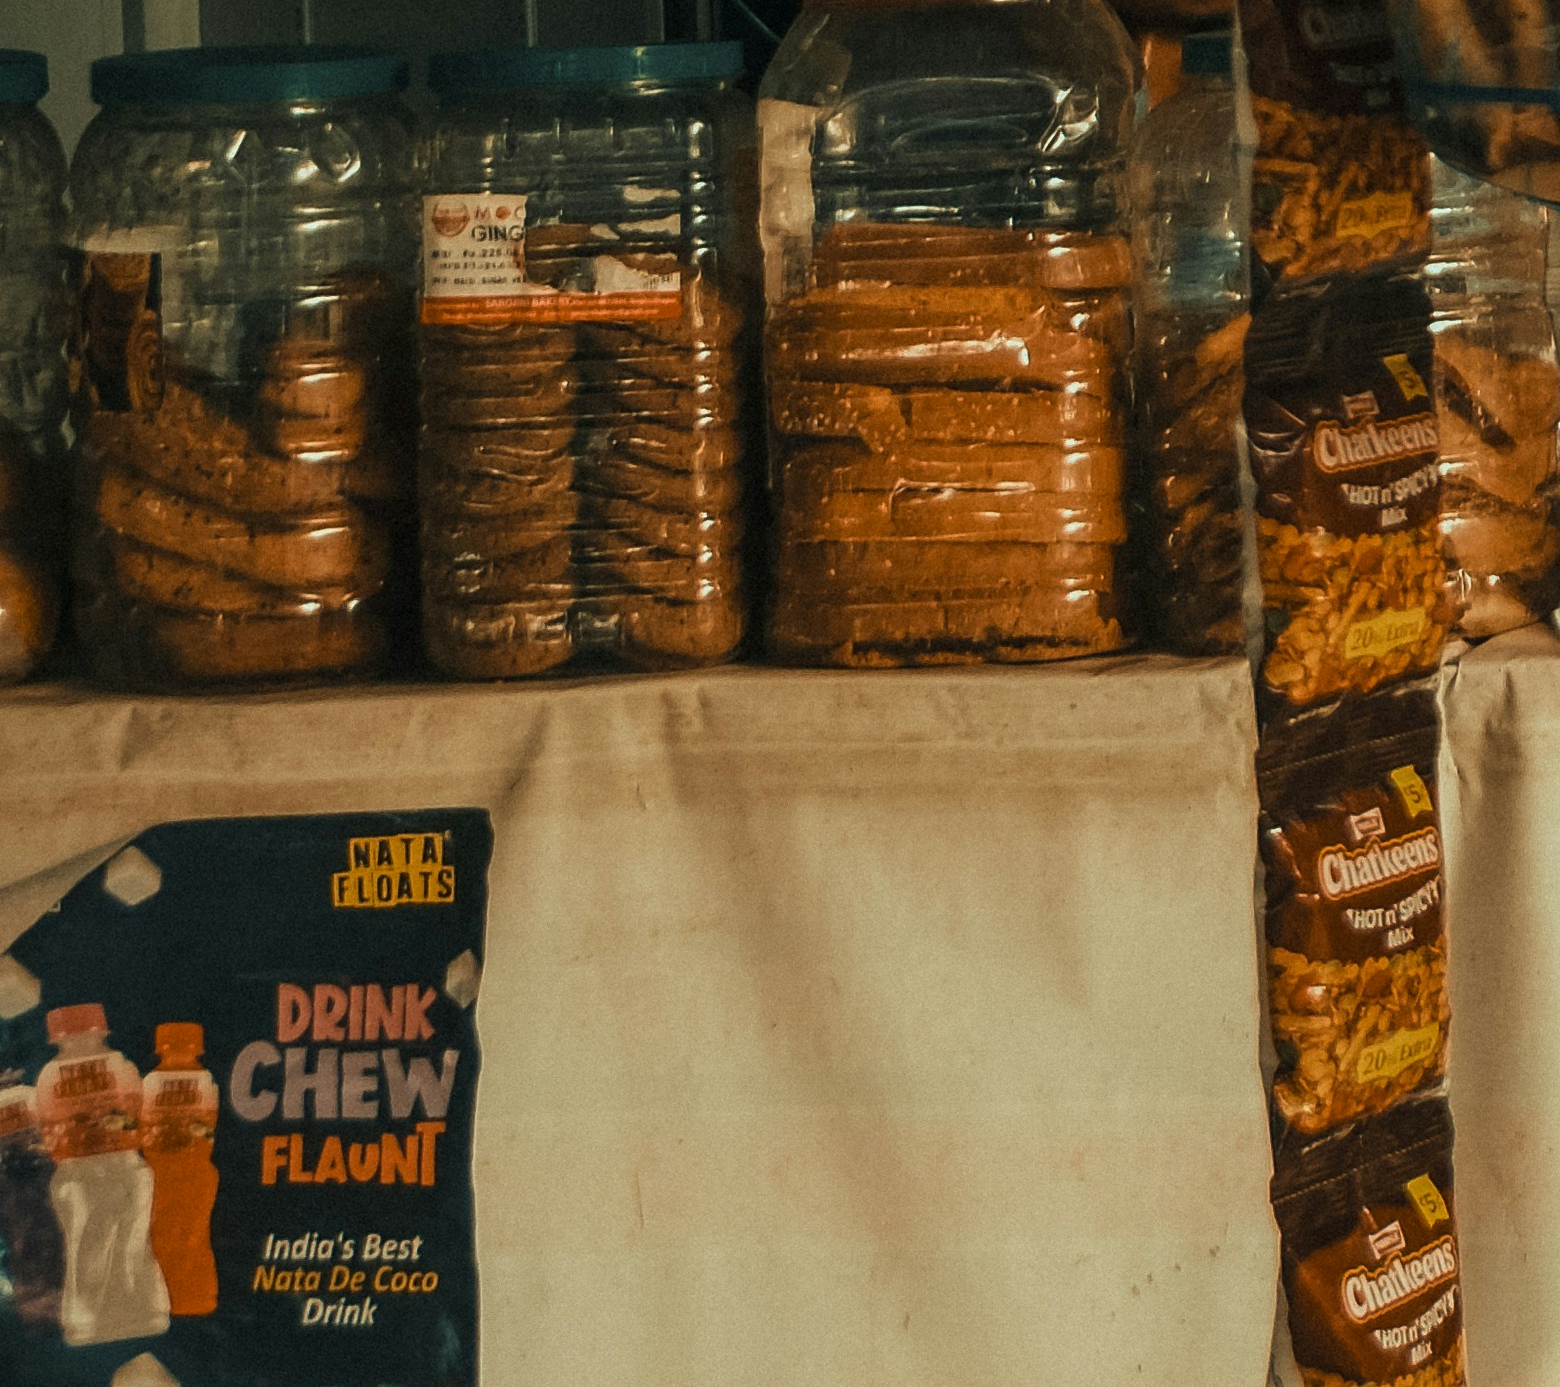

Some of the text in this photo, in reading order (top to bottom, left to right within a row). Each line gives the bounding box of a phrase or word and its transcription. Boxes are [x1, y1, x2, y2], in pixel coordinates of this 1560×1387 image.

[1318, 419, 1438, 468] Chatkeens
[351, 838, 442, 868] NATA
[1322, 832, 1440, 896] Chatkeens
[335, 868, 455, 905] FLOATS
[277, 983, 437, 1042] DRINK
[230, 1041, 459, 1122] CHEW
[261, 1122, 447, 1187] FLAUNT
[263, 1232, 423, 1261] India's Best
[253, 1265, 439, 1293] Nata De Coco
[1345, 1241, 1456, 1318] Chatkeens
[302, 1298, 377, 1327] Drink
